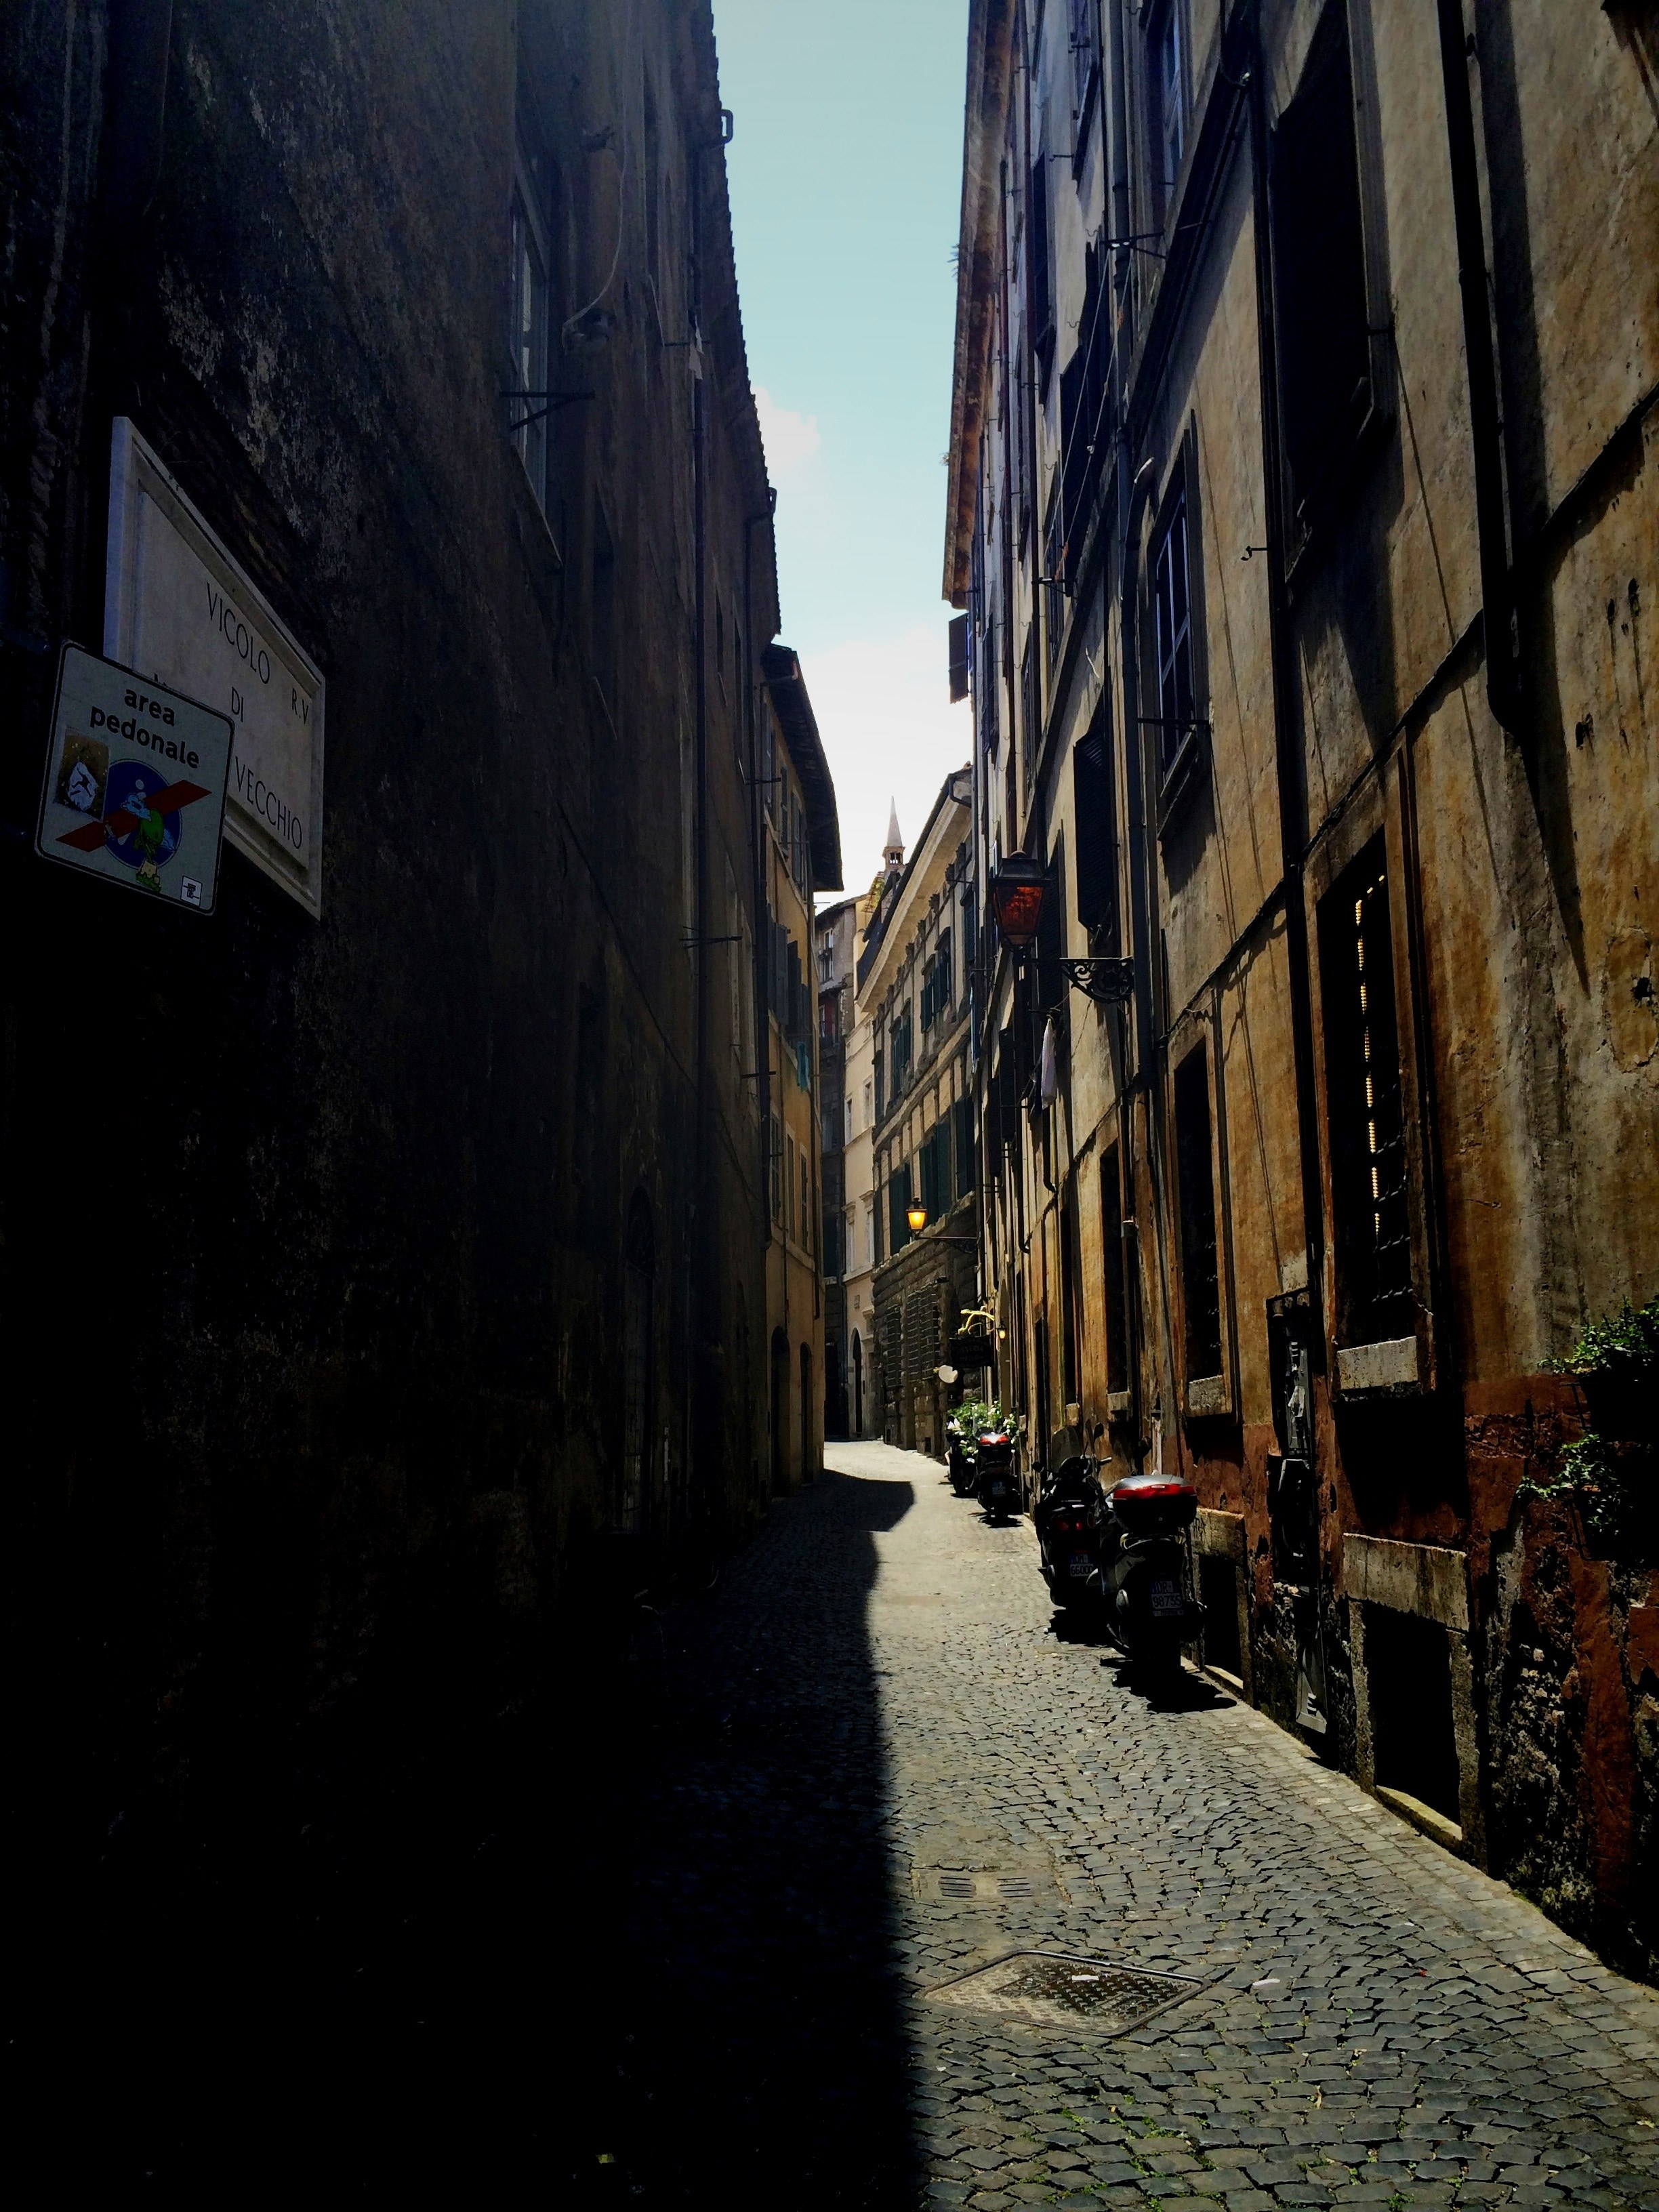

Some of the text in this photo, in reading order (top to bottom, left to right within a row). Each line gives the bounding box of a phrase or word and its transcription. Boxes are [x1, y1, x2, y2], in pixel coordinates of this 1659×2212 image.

[207, 582, 270, 684] VICOLO
[124, 689, 175, 726] area
[231, 687, 244, 722] DI
[89, 705, 199, 769] pedonale
[236, 756, 302, 848] VECCHIO
[1152, 1595, 1183, 1607] 98735
